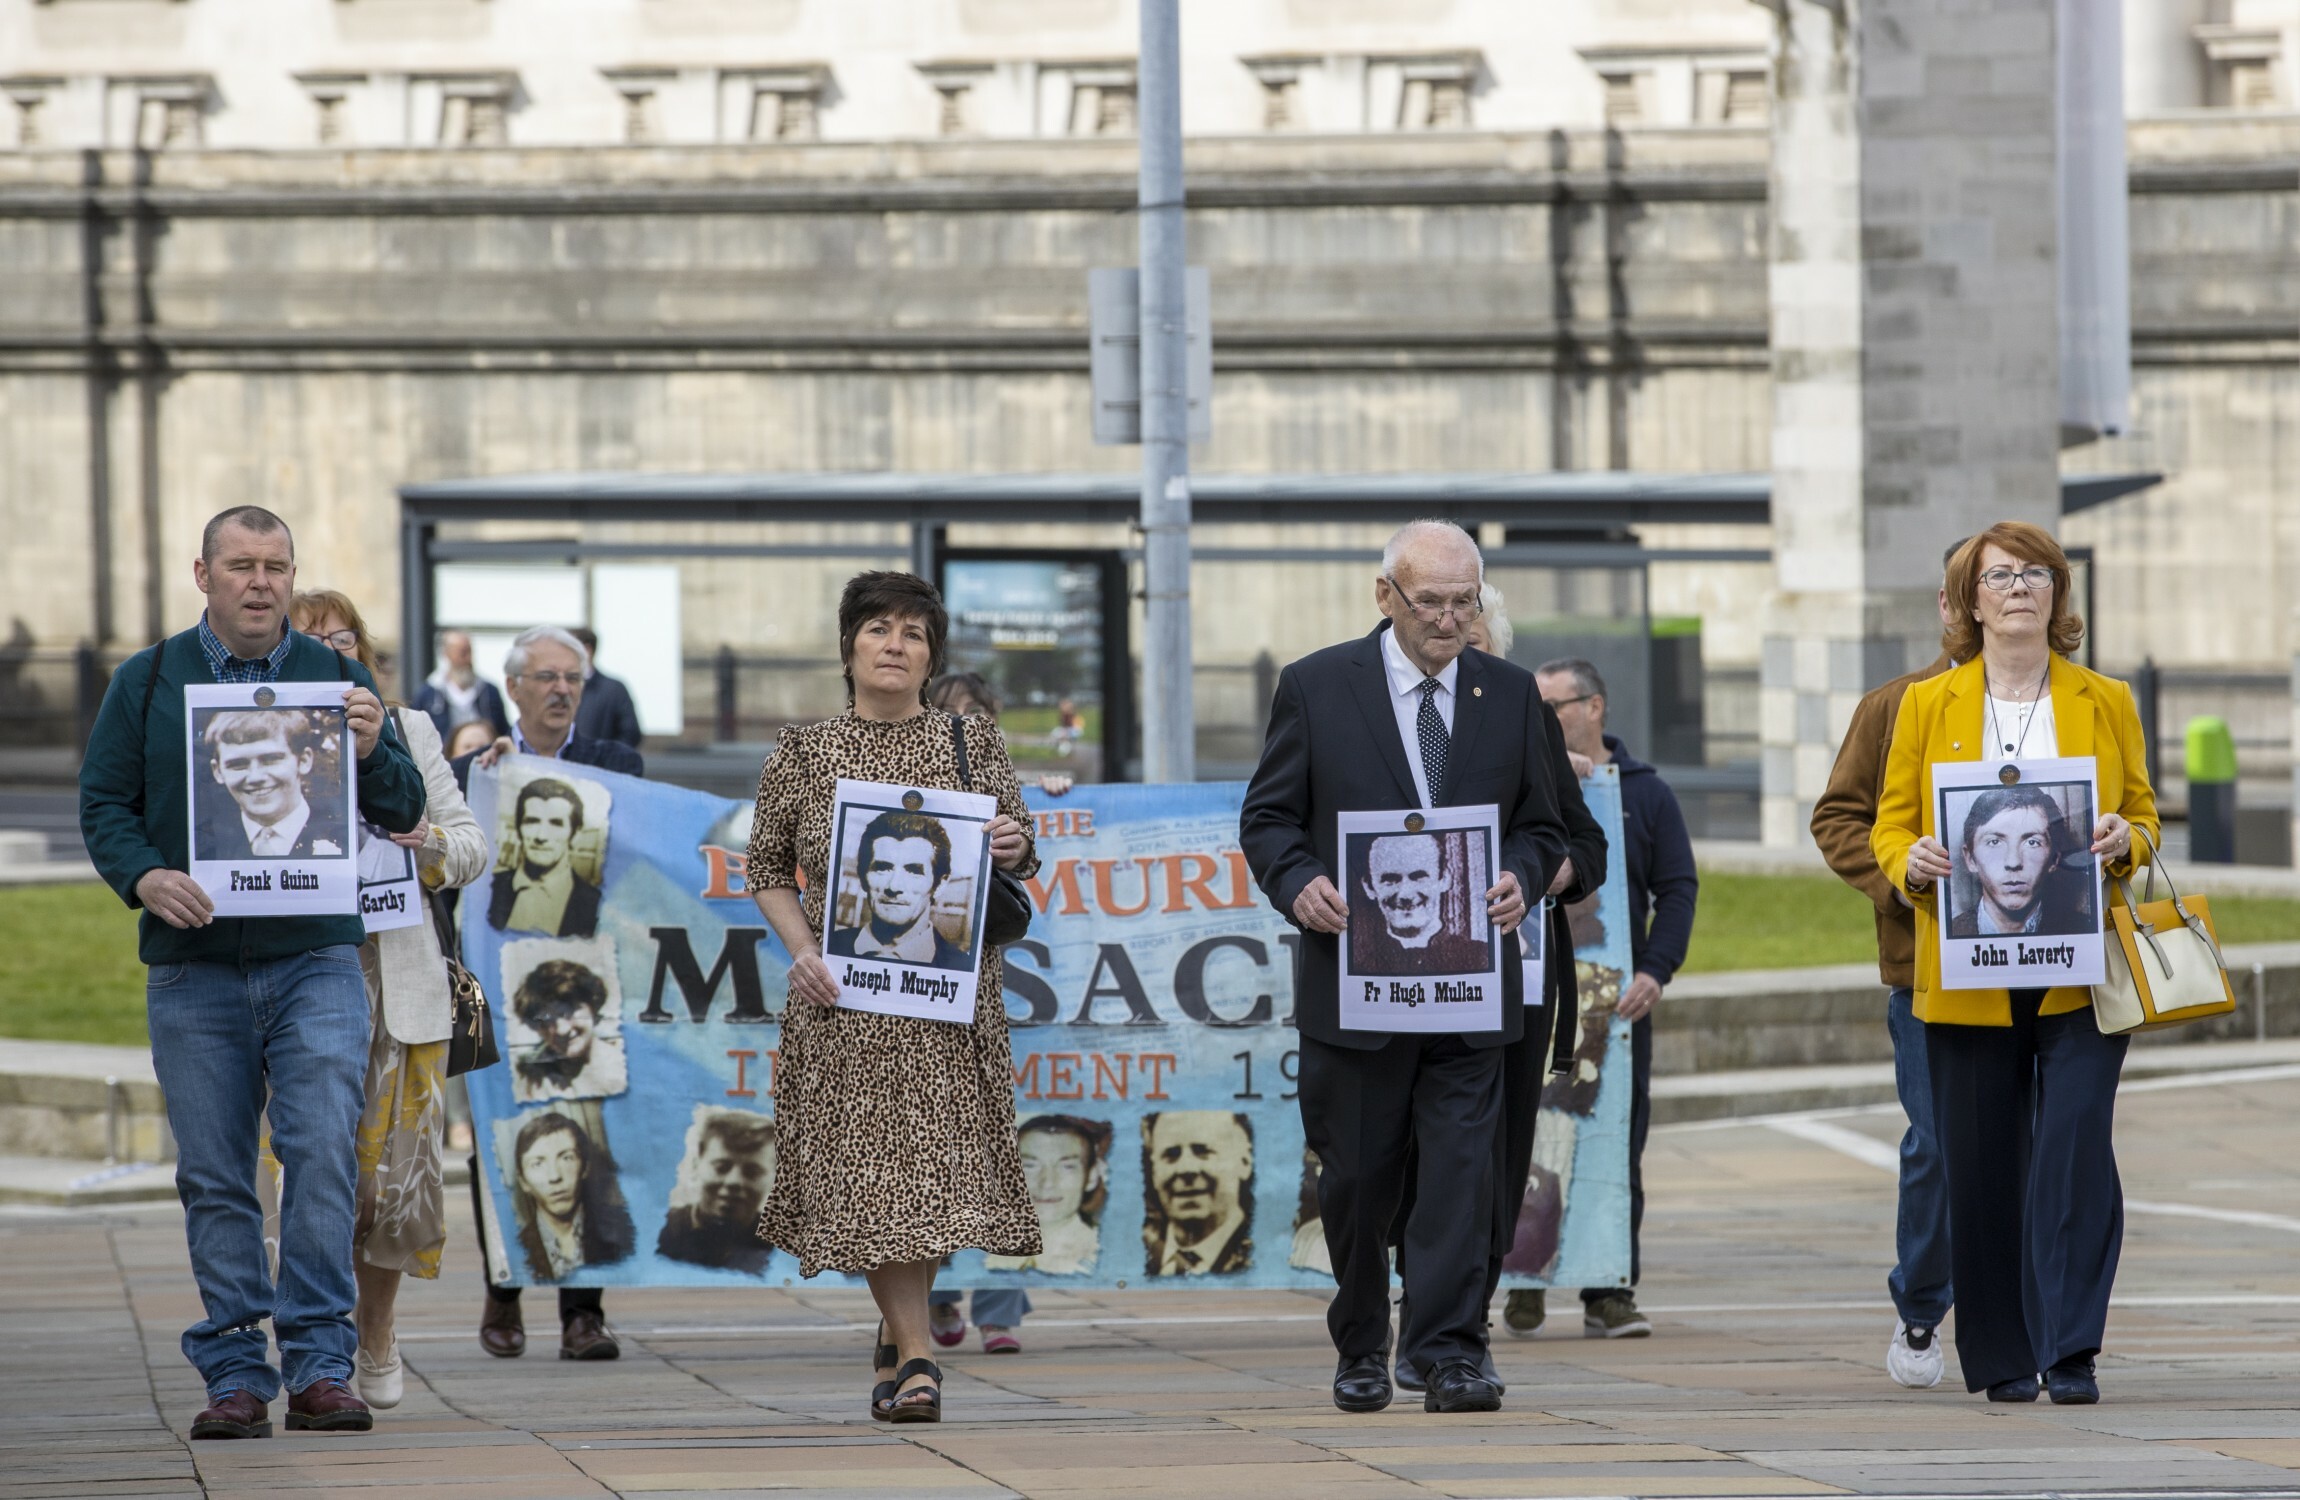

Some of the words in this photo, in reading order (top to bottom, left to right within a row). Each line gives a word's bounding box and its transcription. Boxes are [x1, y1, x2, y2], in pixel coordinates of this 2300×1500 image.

[230, 870, 272, 892] Frank
[280, 869, 319, 891] Quinn
[1971, 944, 2009, 967] John
[2018, 941, 2075, 969] Laverty
[843, 963, 891, 995] Joseph
[900, 970, 959, 1004] Murphy
[1364, 981, 1381, 1002] Fr
[1390, 981, 1425, 1007] Hugh
[1434, 981, 1483, 1003] Mullan
